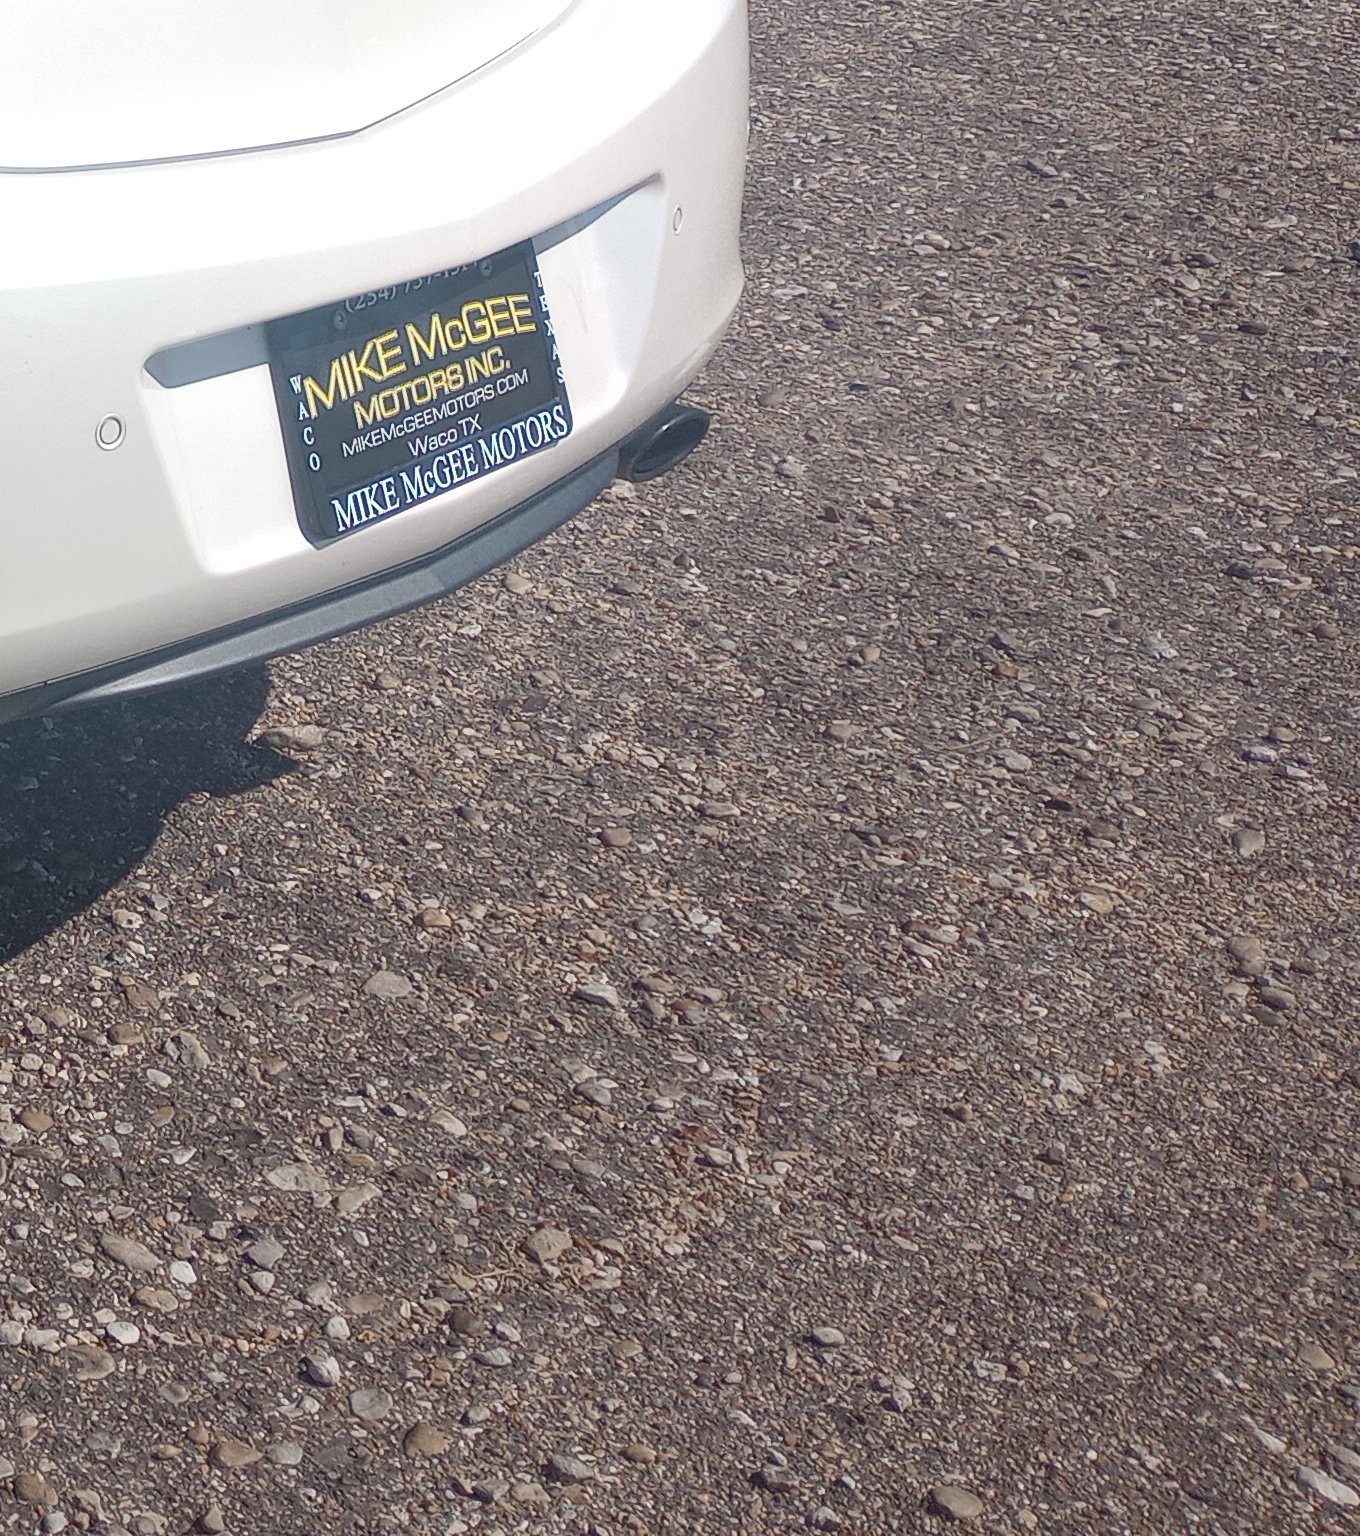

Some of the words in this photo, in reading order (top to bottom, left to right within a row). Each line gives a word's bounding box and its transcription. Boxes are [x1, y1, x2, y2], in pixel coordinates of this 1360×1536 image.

[302, 328, 407, 420] MIKE
[405, 293, 537, 366] McGEE
[353, 364, 465, 430] MOTORS
[464, 345, 511, 385] INC.
[289, 374, 322, 472] WACO
[341, 368, 529, 459] MIKEMcGEEMOTORS.COM
[408, 429, 458, 458] Waco
[459, 413, 483, 437] TX
[330, 476, 400, 533] MIKE
[399, 442, 480, 504] McGEE
[478, 404, 569, 470] MOTORS
